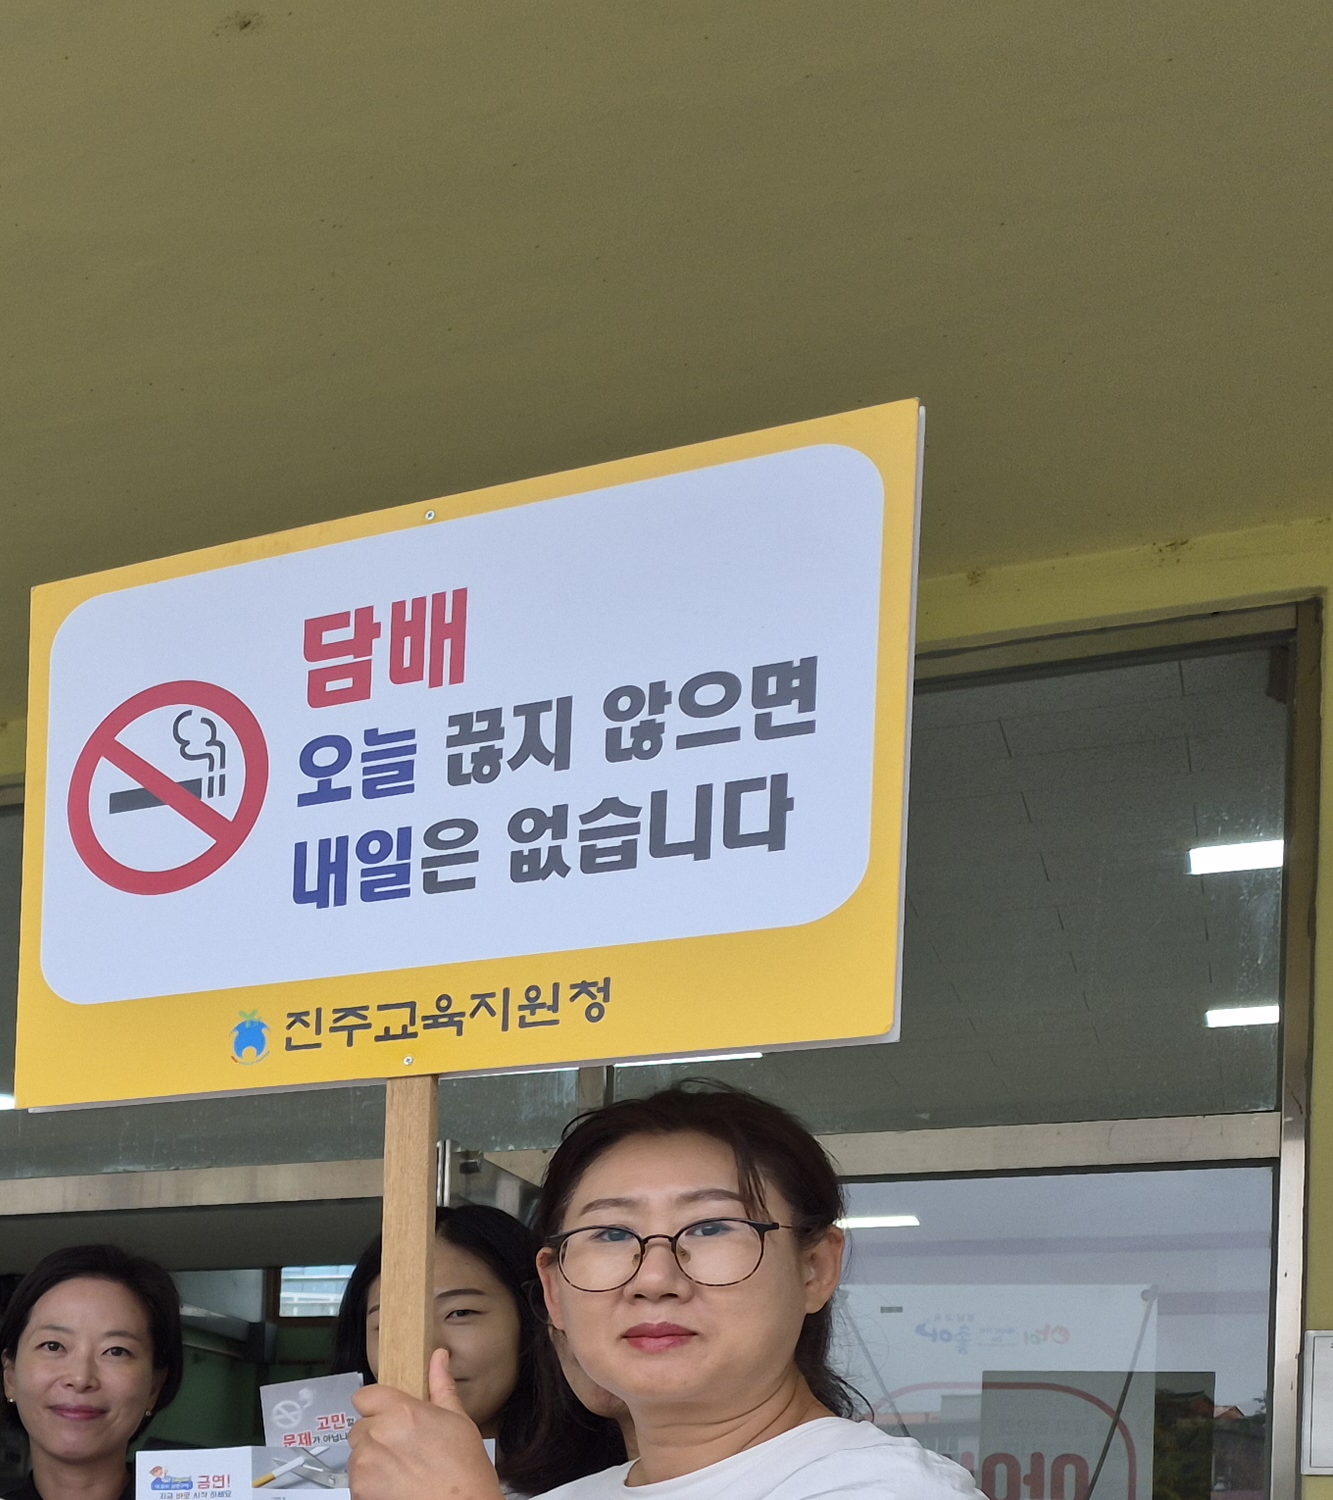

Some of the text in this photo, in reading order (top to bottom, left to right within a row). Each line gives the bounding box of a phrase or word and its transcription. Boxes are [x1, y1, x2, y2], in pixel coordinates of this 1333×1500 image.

[303, 586, 468, 709] 담배
[296, 656, 818, 808] 오늘 끊지 않으면
[291, 772, 794, 909] 내일은 없습니다
[284, 977, 613, 1053] 진주교육지원청
[197, 1474, 230, 1489] 금연!
